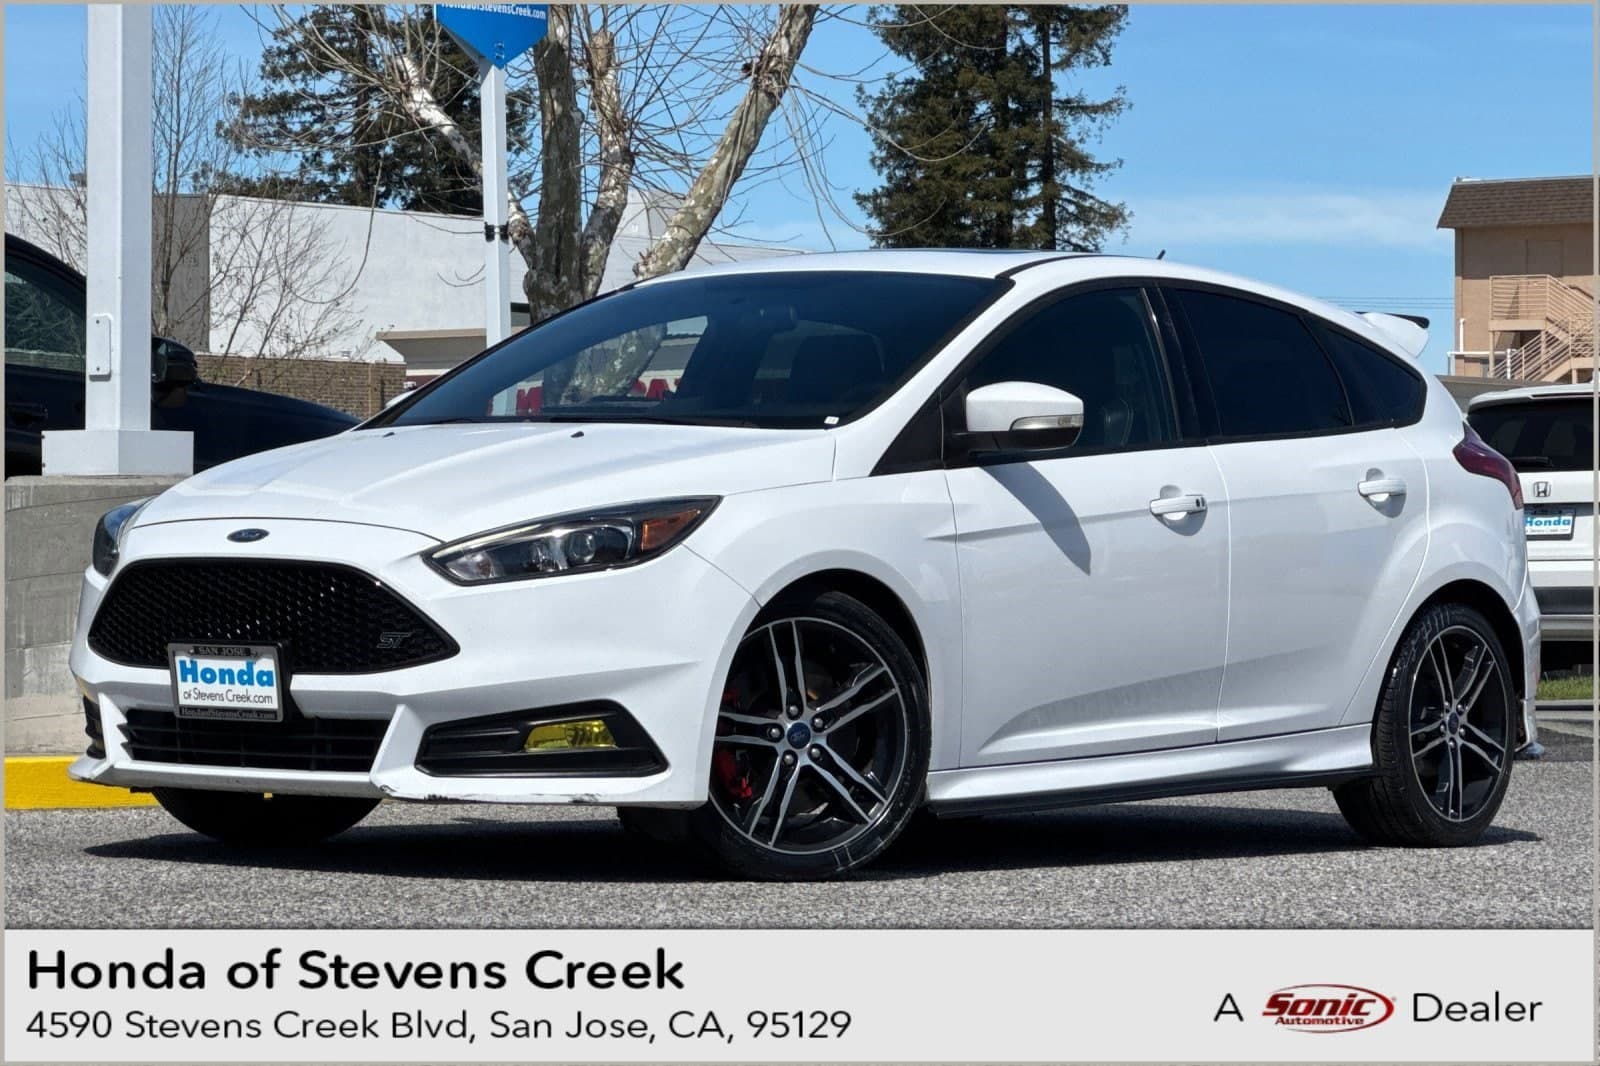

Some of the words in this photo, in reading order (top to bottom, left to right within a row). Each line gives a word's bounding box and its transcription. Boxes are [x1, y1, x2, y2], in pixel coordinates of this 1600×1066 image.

[1525, 515, 1571, 527] Honda
[376, 631, 413, 649] ST
[179, 659, 275, 687] Honda
[183, 689, 192, 700] of
[193, 688, 224, 702] Stevens
[226, 689, 273, 704] Creek.com
